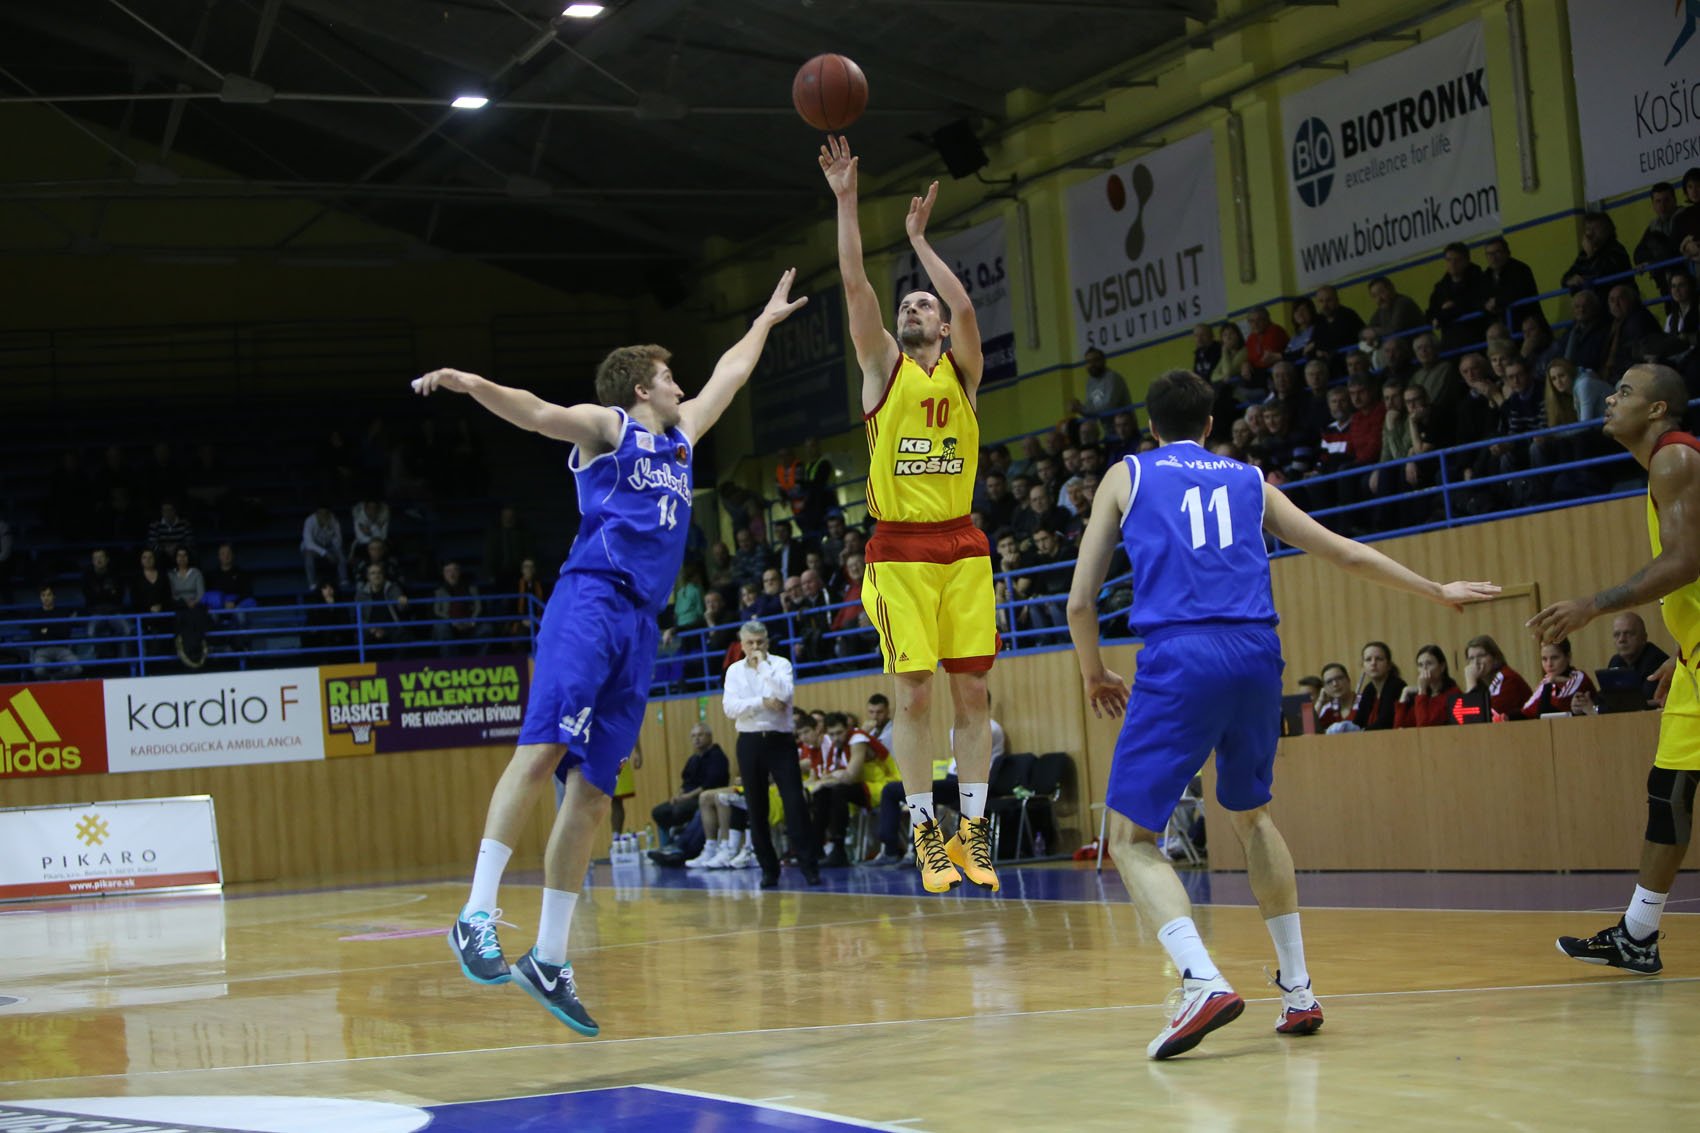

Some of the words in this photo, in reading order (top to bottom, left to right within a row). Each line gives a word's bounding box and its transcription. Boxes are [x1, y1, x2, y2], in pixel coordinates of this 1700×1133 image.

[1342, 68, 1489, 158] BIOTRONIK
[1345, 155, 1408, 188] excellence
[1410, 143, 1429, 165] for
[1431, 133, 1451, 157] life
[1640, 135, 1700, 173] EURÓPSK
[1301, 185, 1499, 273] www.biotronik.com
[1075, 258, 1167, 323] VISION
[1177, 244, 1203, 291] IT
[1087, 295, 1202, 347] SOLUTIONS
[920, 397, 950, 429] 10
[899, 438, 932, 454] KB
[1180, 485, 1233, 550] 11
[399, 666, 520, 690] VÝCHOVA
[128, 689, 268, 731] kardio
[280, 685, 298, 722] F
[400, 684, 520, 709] TALENTOV
[330, 702, 390, 724] BASKET
[401, 712, 422, 728] PRE
[424, 705, 484, 728] KOŠICKÝCH
[486, 703, 521, 723] BÝKOV
[0, 741, 82, 773] idas
[227, 735, 302, 751] AMBULANCIA
[42, 849, 157, 869] PIKARO
[69, 878, 136, 892] www.pikaro.sk
